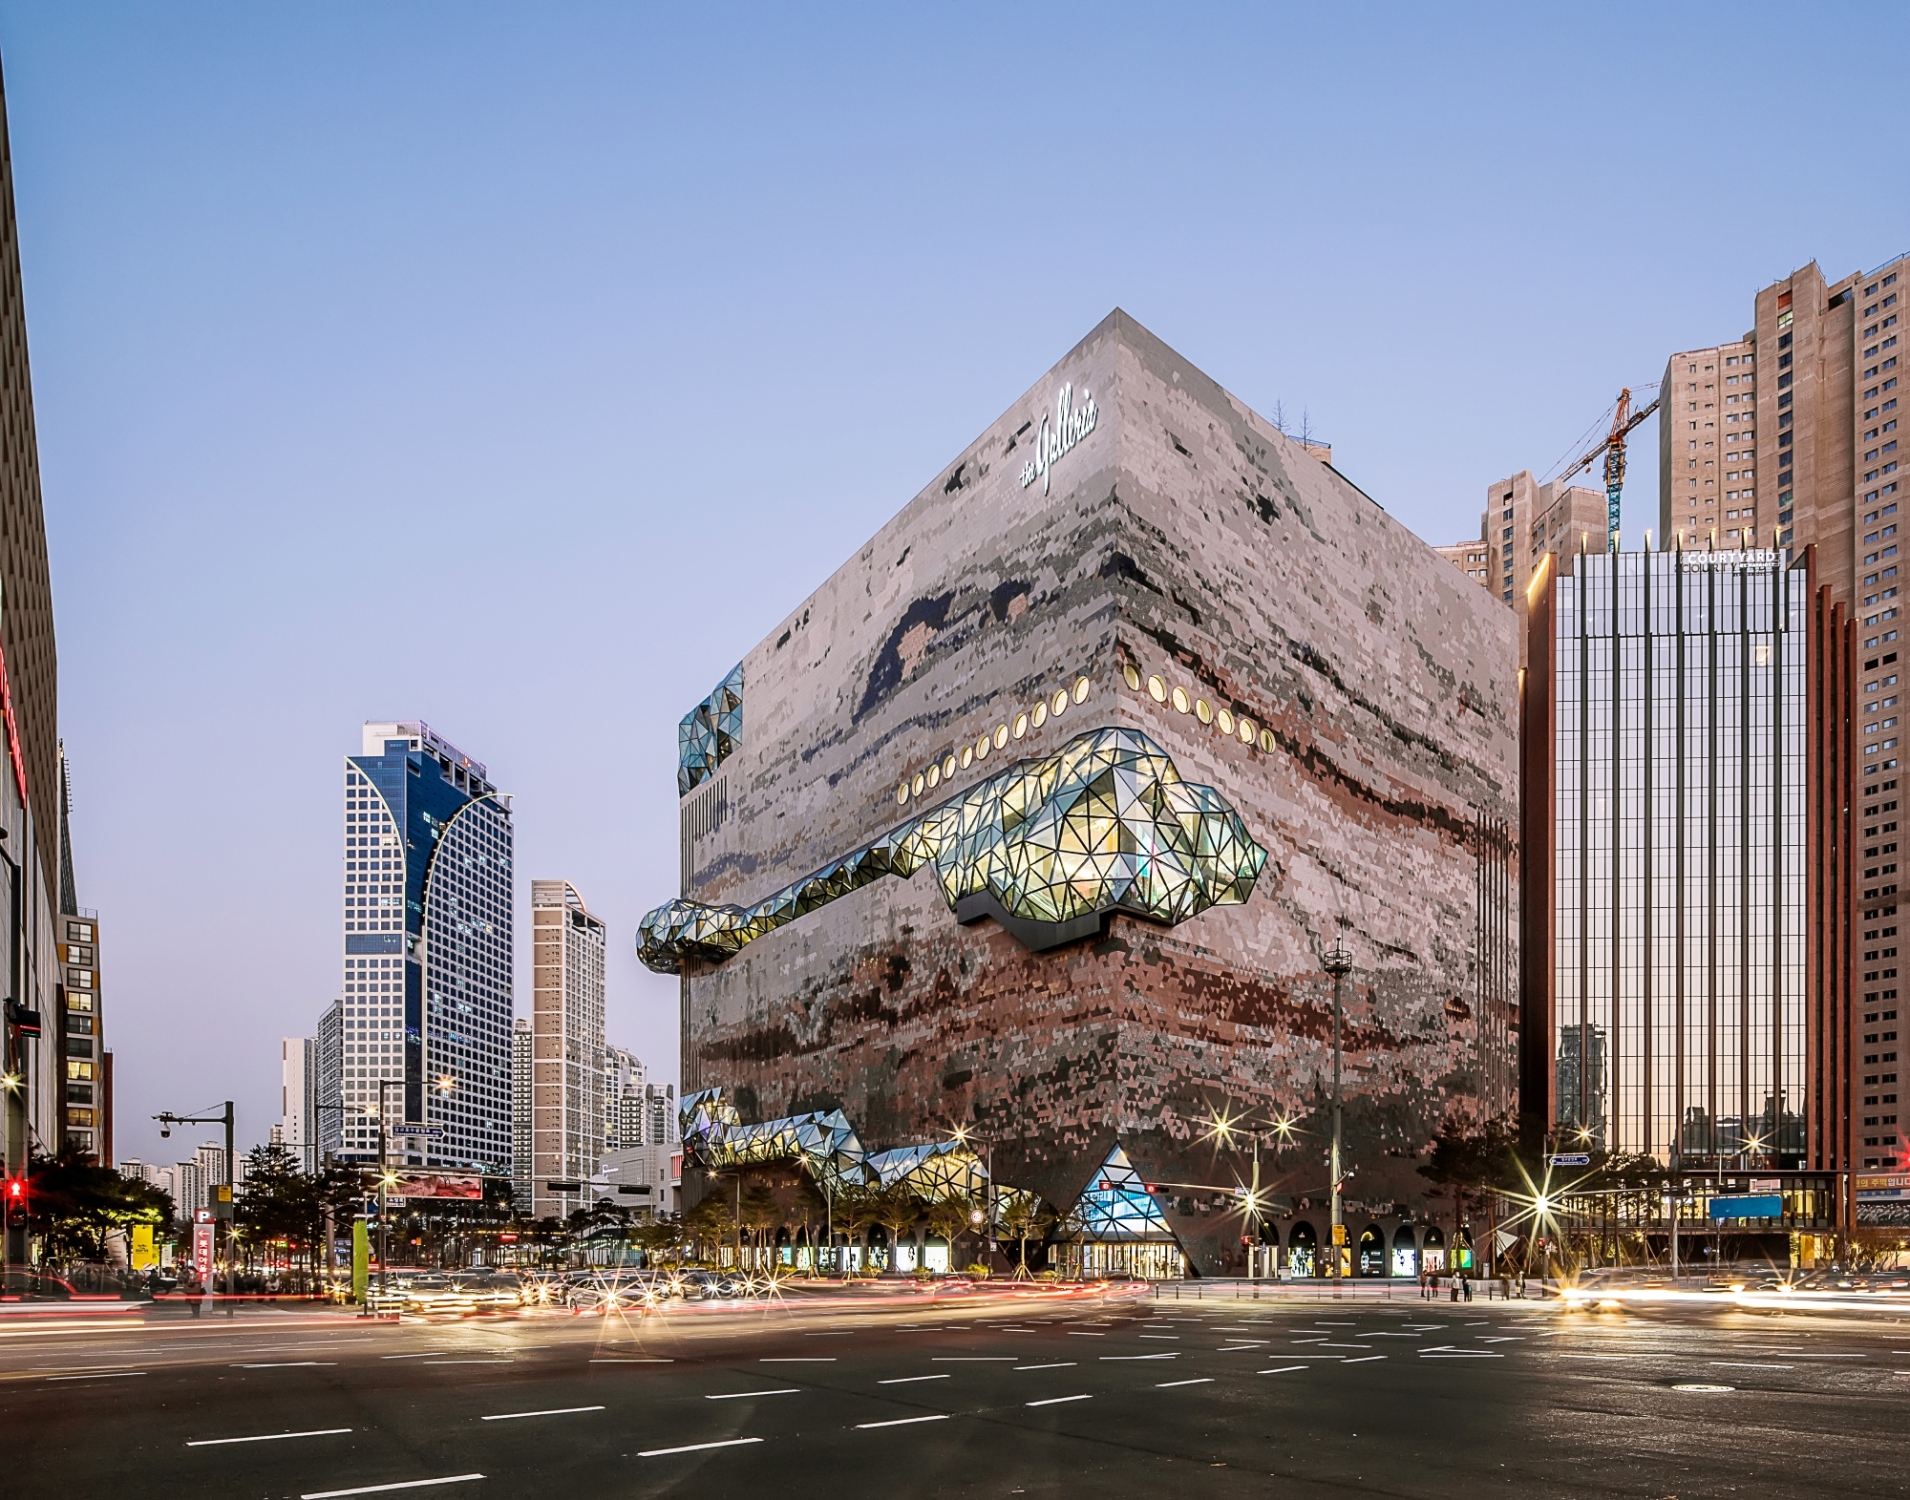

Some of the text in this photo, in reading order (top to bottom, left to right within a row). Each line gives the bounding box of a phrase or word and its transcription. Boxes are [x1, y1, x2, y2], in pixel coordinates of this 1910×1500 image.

[1035, 381, 1098, 496] Galleria
[1687, 552, 1776, 565] COURTYARD
[198, 1211, 210, 1223] P
